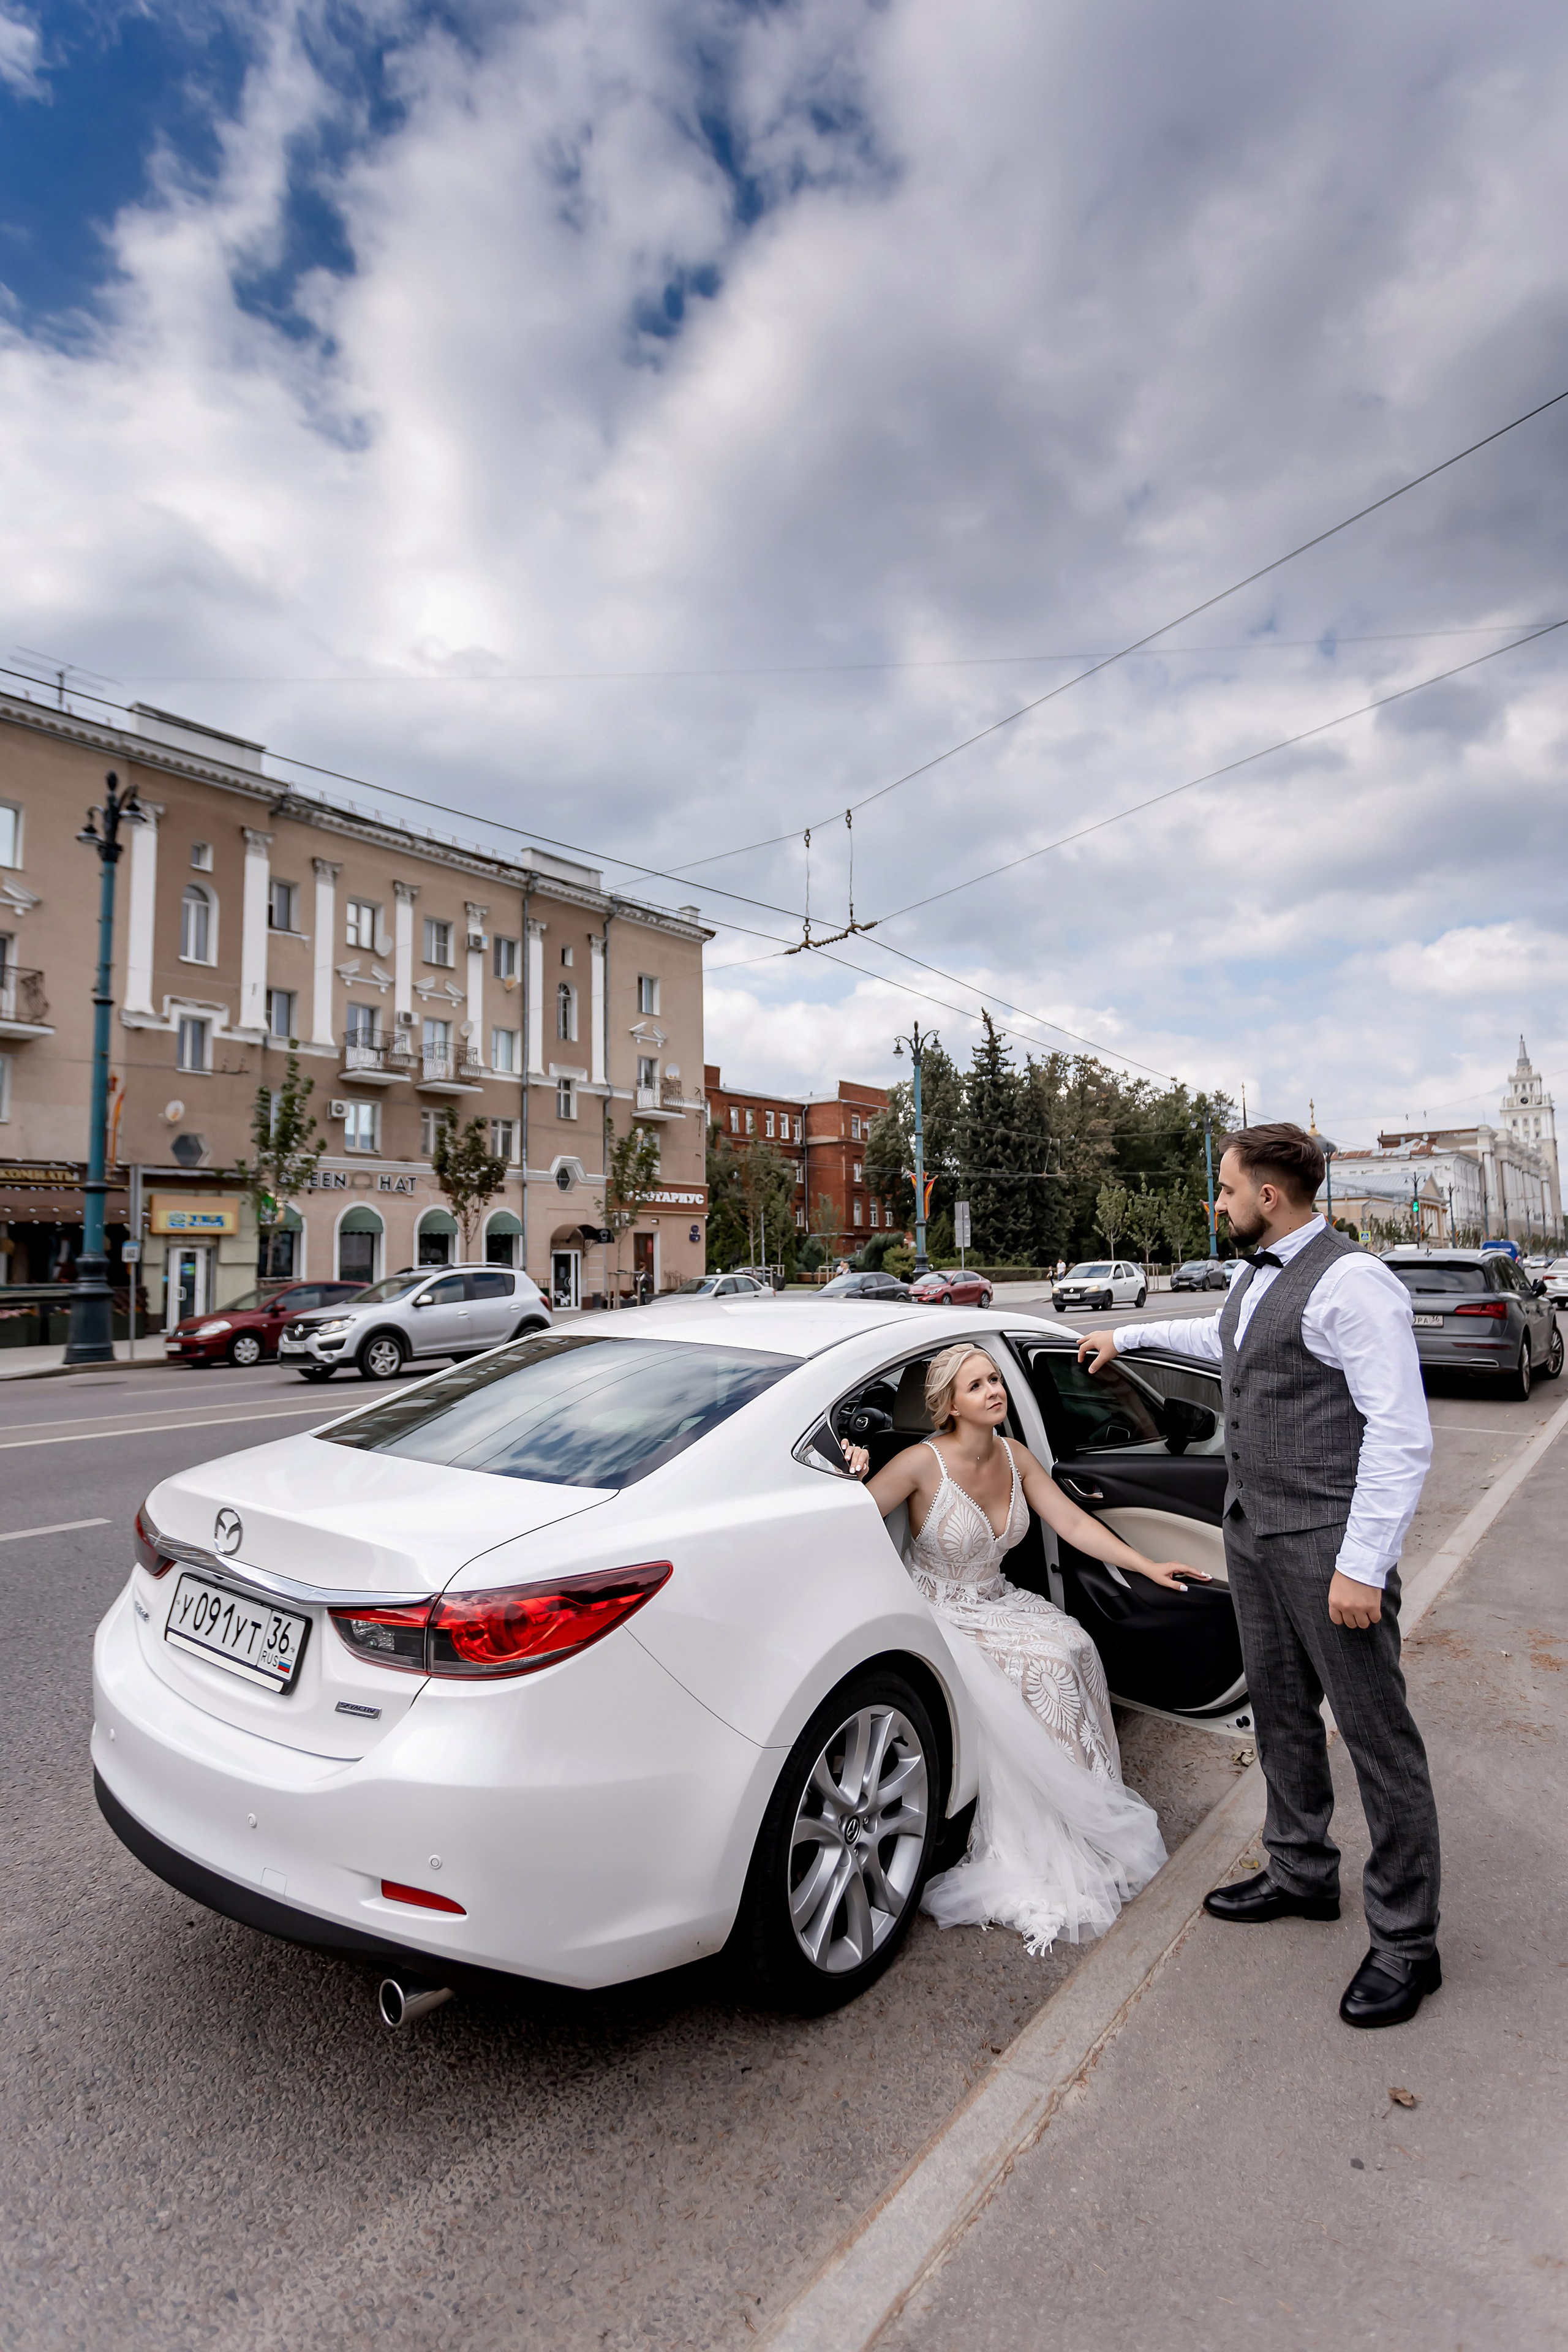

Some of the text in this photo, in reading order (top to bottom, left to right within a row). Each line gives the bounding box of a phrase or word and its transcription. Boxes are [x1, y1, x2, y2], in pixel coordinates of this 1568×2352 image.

[278, 1170, 417, 1193] GEEN HAT
[267, 1616, 292, 1654] 36
[260, 1650, 278, 1667] RUS
